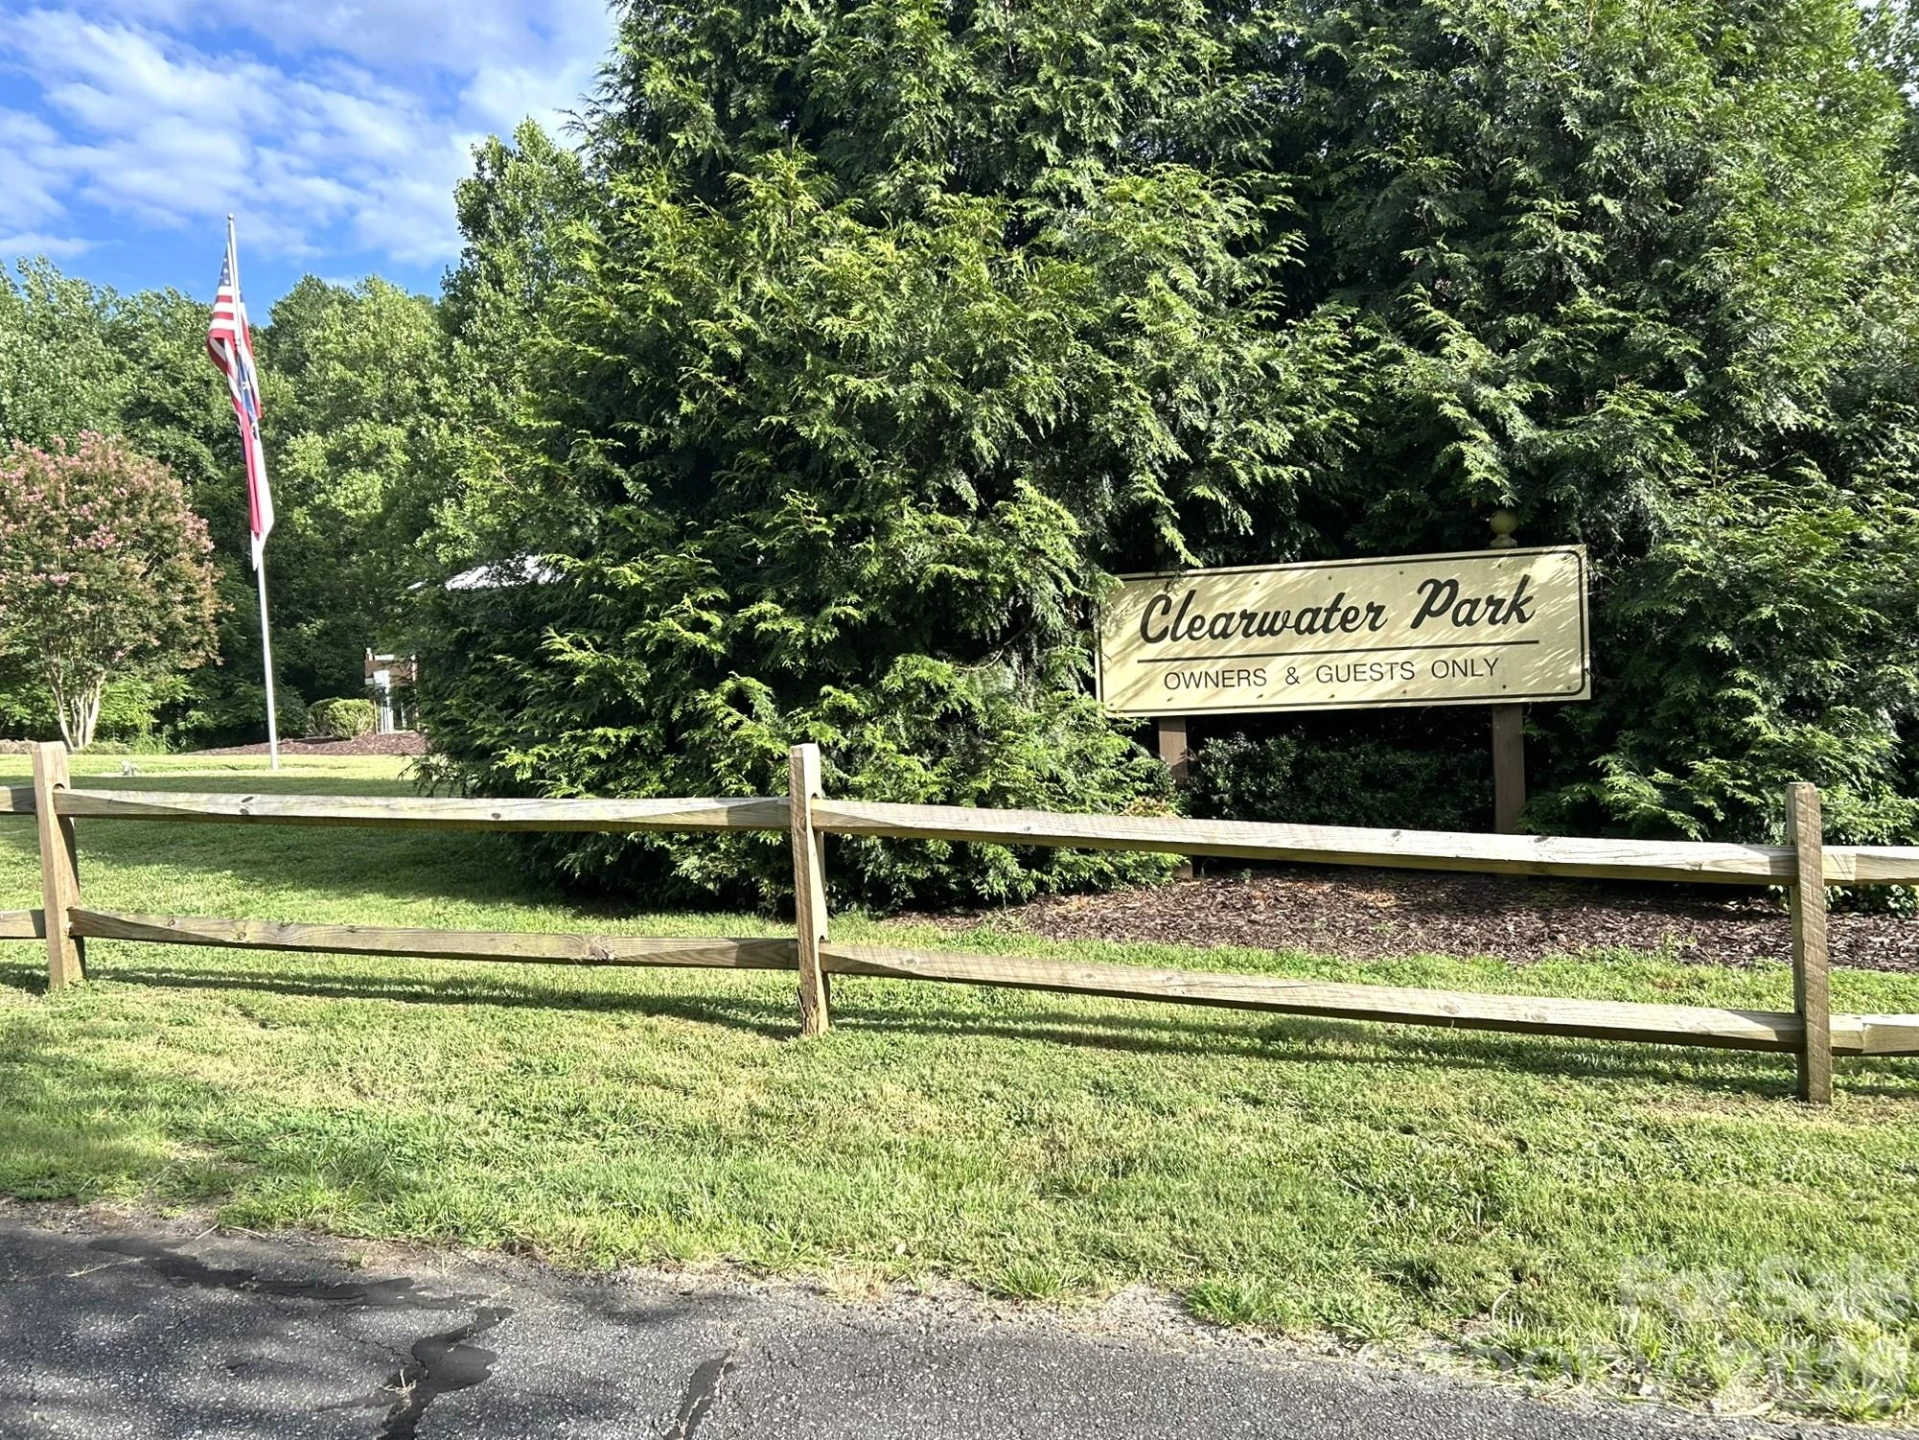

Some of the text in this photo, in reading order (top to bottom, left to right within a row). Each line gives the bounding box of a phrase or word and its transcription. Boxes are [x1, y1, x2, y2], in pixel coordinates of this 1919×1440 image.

[1138, 574, 1535, 645] Clearwater Park
[1163, 657, 1499, 691] OWNERS & GUESTS ONLY
